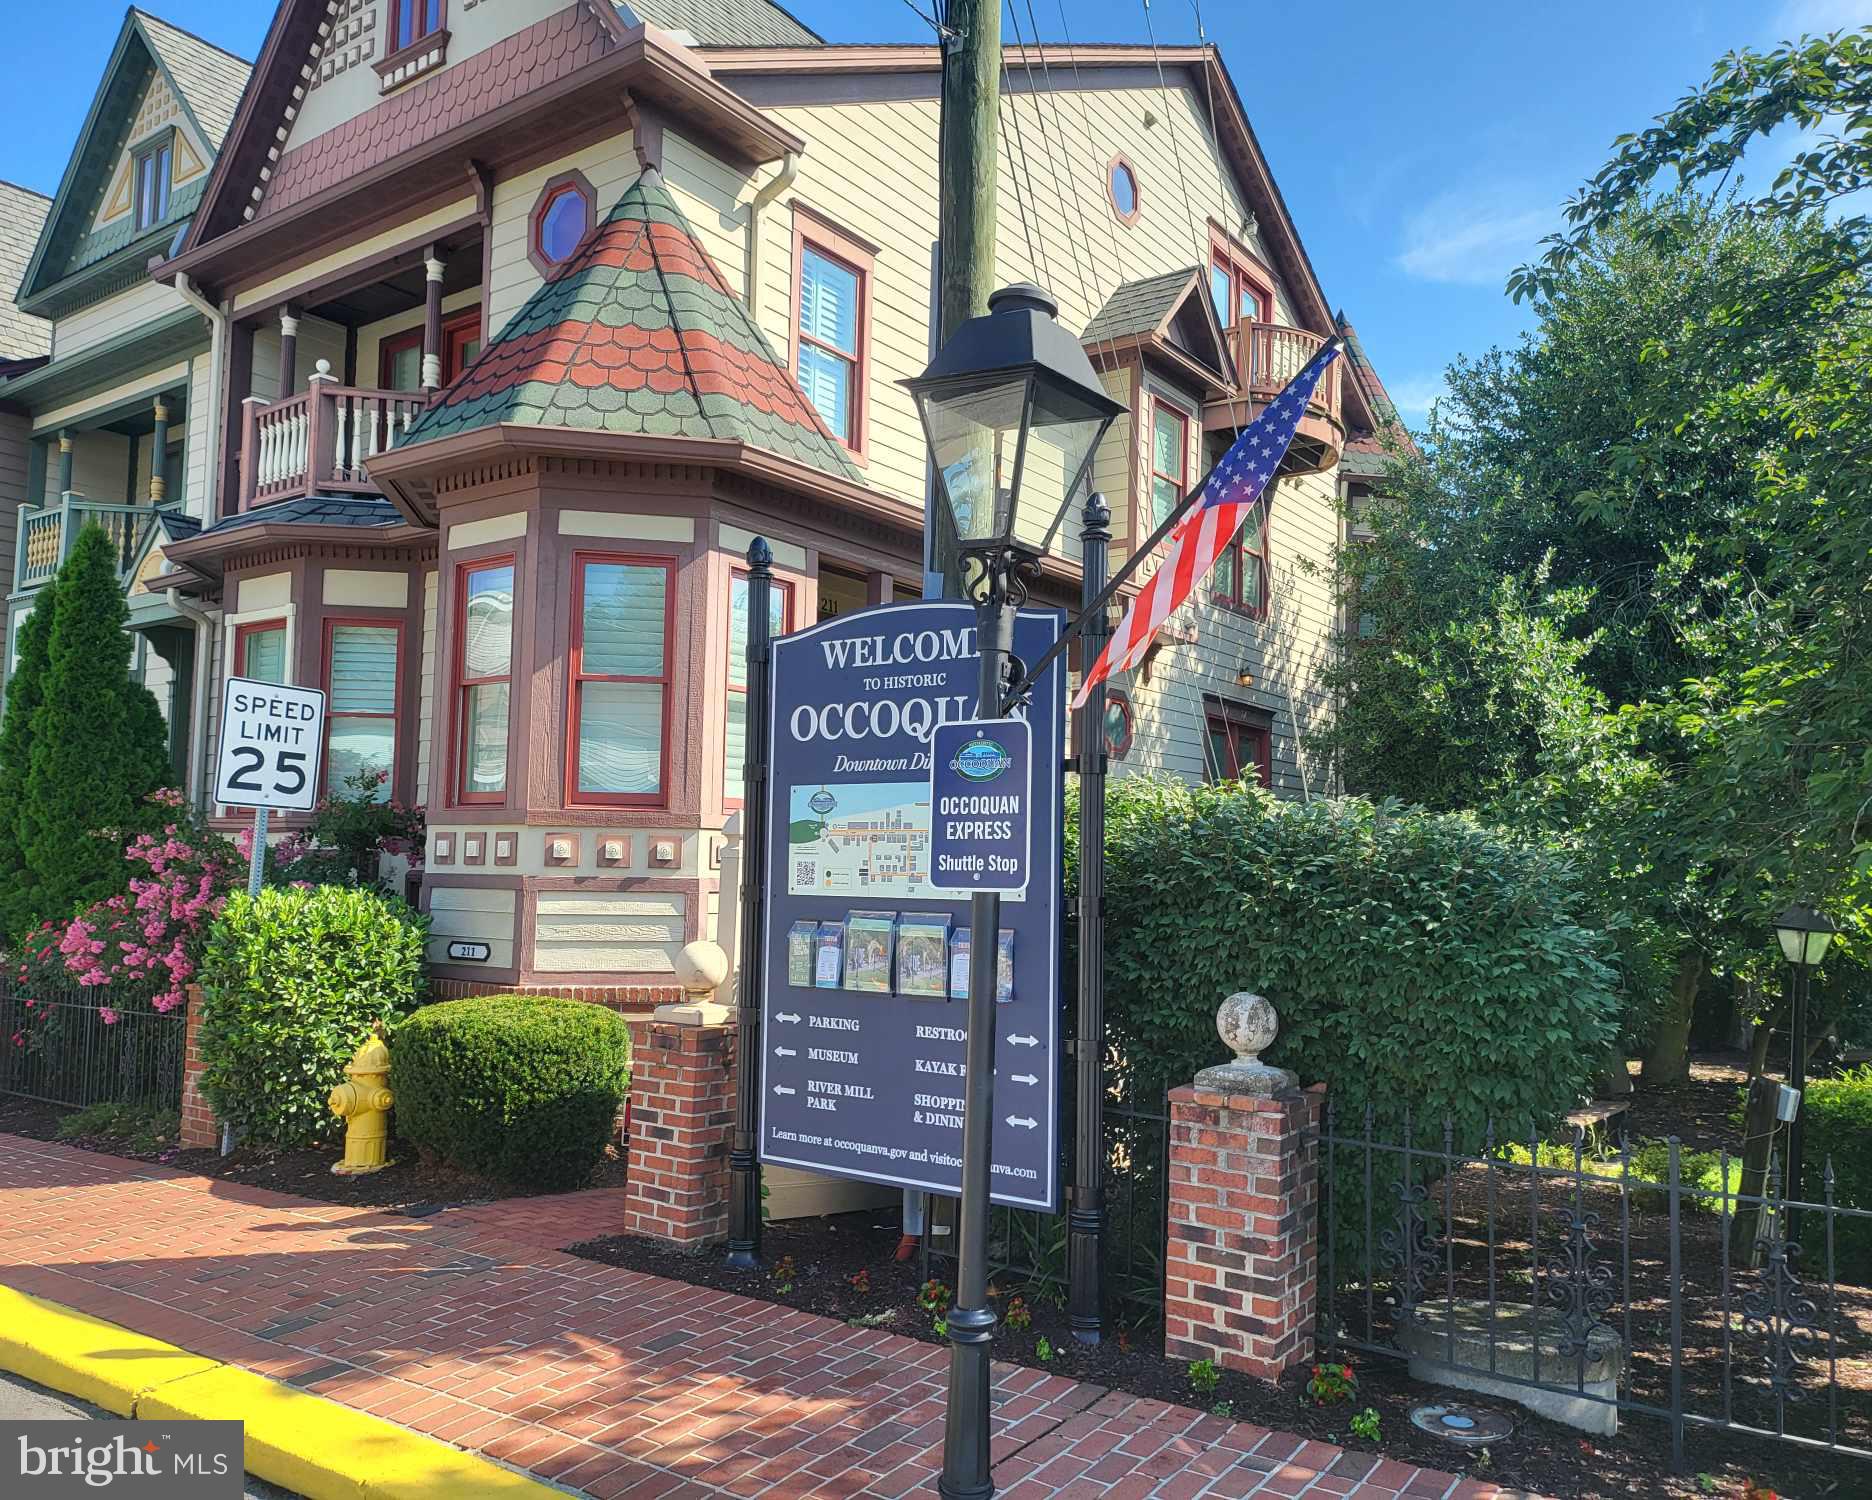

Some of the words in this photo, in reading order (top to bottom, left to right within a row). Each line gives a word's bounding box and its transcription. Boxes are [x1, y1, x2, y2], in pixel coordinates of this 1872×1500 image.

[821, 598, 839, 616] 211
[820, 627, 981, 670] WELCOM
[863, 678, 881, 690] TO
[884, 672, 947, 689] HISTORIC
[233, 694, 315, 721] SPEED
[790, 696, 1027, 743] OCCOQU
[240, 720, 304, 745] LIMIT
[226, 746, 306, 795] 25
[833, 753, 908, 772] Downtown
[949, 757, 1012, 770] OCCOQUAN
[940, 795, 1020, 816] OCCOQUAN
[946, 821, 1012, 840] EXPRESS
[938, 854, 984, 872] Shuttle
[988, 854, 1018, 875] Stop
[461, 946, 475, 957] 211
[808, 1015, 860, 1032] PARKING
[807, 1047, 860, 1065] MUSEUM
[915, 1059, 958, 1076] KAYAK
[807, 1080, 843, 1096] RIVER
[844, 1084, 875, 1100] MILL
[806, 1096, 837, 1111] PARK
[913, 1110, 923, 1123] &
[924, 1111, 965, 1129] DININ
[771, 1126, 797, 1141] Learn
[798, 1133, 822, 1145] more
[823, 1136, 833, 1147] at
[834, 1139, 908, 1160] occoquanva.gov
[909, 1148, 928, 1162] and
